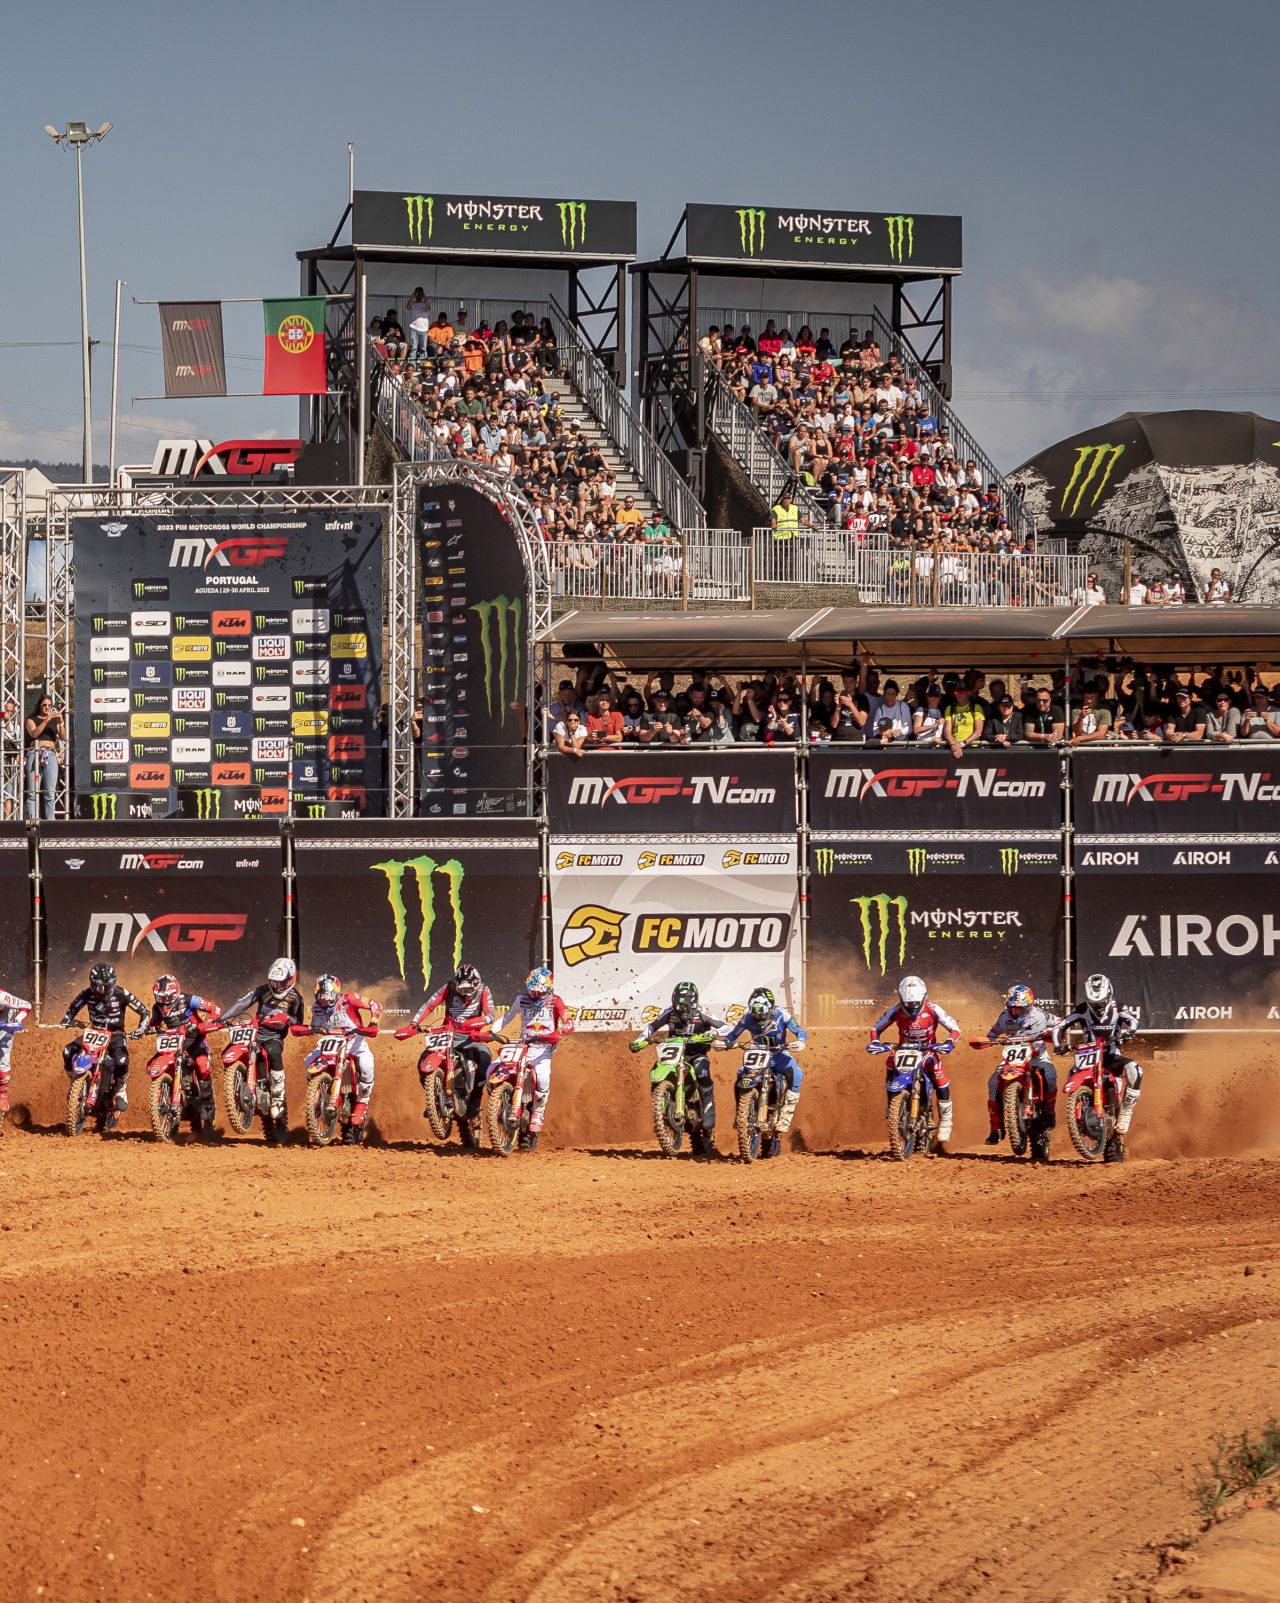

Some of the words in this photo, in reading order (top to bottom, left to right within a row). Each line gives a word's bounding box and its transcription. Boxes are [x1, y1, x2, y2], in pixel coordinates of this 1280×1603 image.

[447, 201, 543, 221] MONSTER
[464, 223, 528, 232] ENERGY
[778, 214, 871, 234] MONSTER
[795, 236, 858, 245] ENERGY
[150, 439, 304, 480] MXGP
[169, 537, 288, 573] MXGP
[206, 576, 258, 585] PORTUGAL
[218, 618, 246, 627] KTM
[259, 639, 285, 647] LIQUI
[259, 648, 285, 656] MOLY
[178, 690, 205, 699] LIQUI
[178, 700, 205, 708] MOLY
[96, 742, 123, 750] LIQUI
[258, 741, 284, 749] LIQUI
[96, 751, 123, 760] MOLY
[258, 750, 284, 758] MOLY
[136, 771, 165, 780] KTM
[217, 770, 245, 780] KTM
[834, 853, 872, 861] MONSTER
[926, 852, 965, 860] MONSTER
[1019, 852, 1058, 860] MONSTER
[1082, 852, 1139, 866] AIROH
[1173, 851, 1230, 865] AIROH
[911, 909, 1022, 926] MONSTER
[83, 913, 248, 957] MXGP
[928, 930, 1006, 938] ENERGY
[1175, 1006, 1232, 1020] AIROH
[85, 1033, 109, 1045] 919
[232, 1028, 254, 1041] 189
[320, 1039, 344, 1052] 101
[428, 1035, 450, 1047] 32
[660, 1047, 679, 1062] 3
[746, 1052, 766, 1066] 91
[1007, 1048, 1027, 1062] 84
[1079, 1053, 1097, 1067] 70
[896, 1054, 917, 1068] 10
